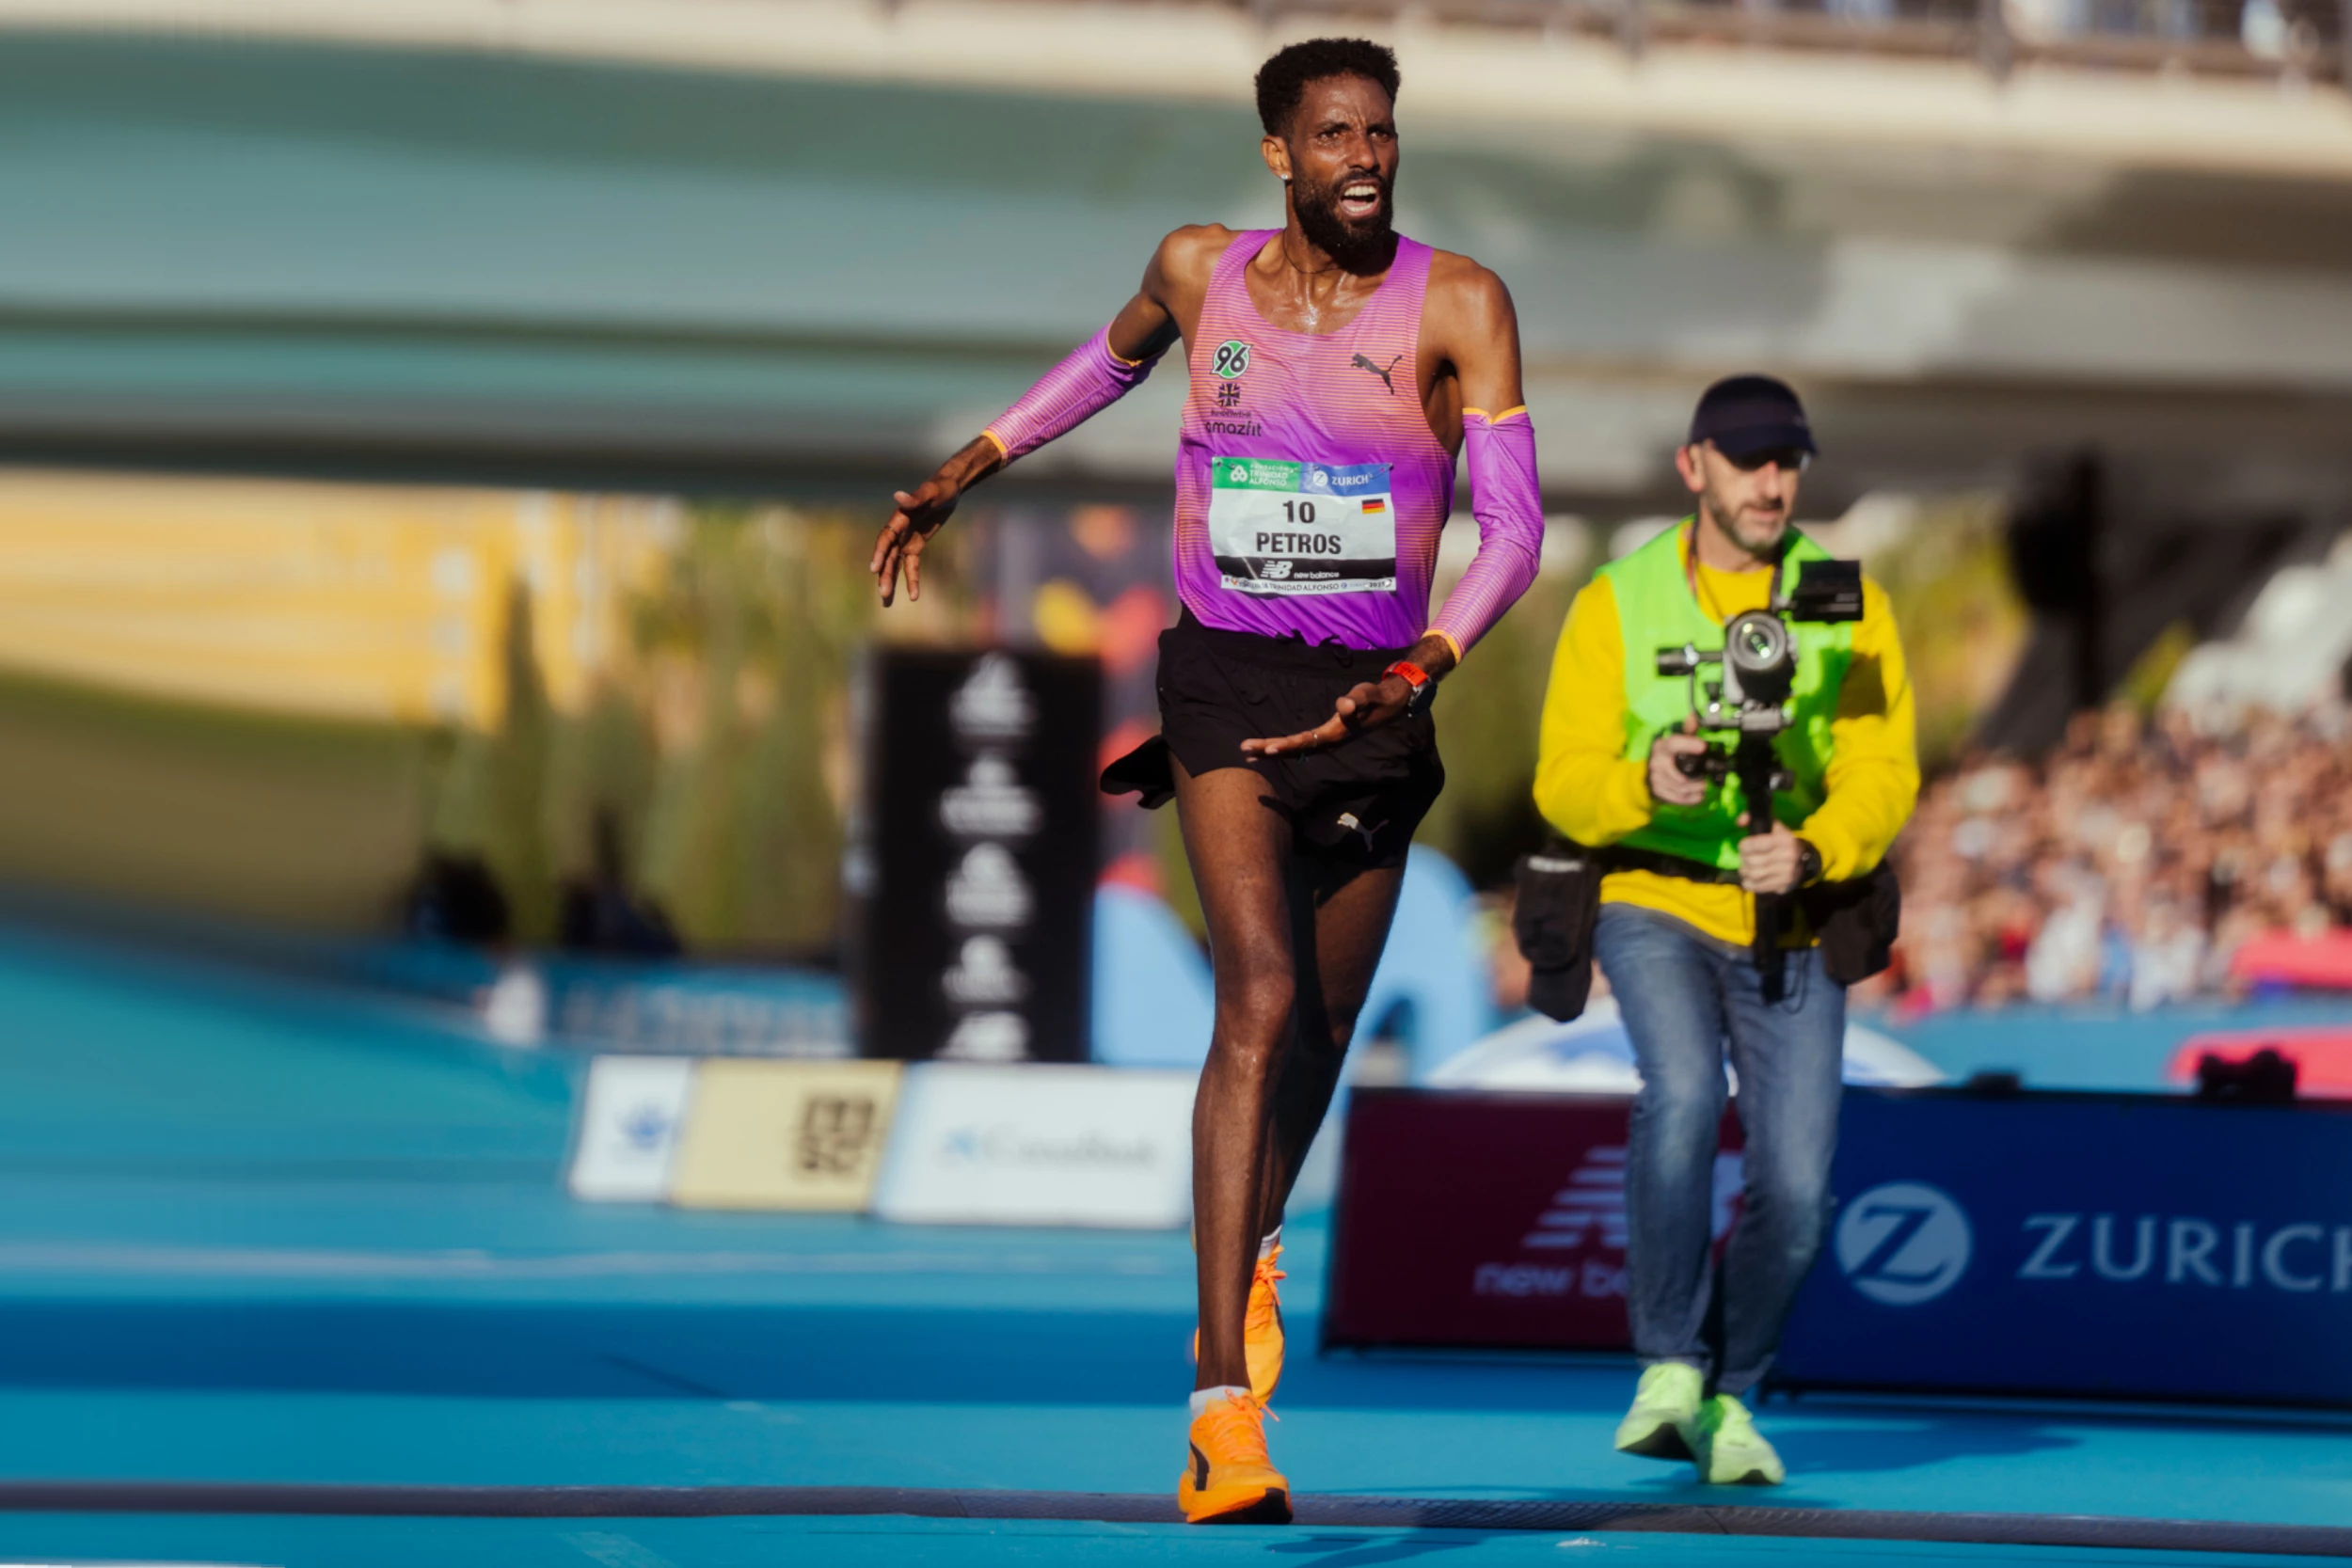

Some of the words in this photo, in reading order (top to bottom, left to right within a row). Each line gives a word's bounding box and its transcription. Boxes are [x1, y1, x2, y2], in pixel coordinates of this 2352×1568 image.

[1215, 344, 1248, 373] 96
[1331, 474, 1369, 486] ZURICH
[1282, 499, 1315, 524] 10
[1256, 531, 1342, 555] PETROS
[1310, 570, 1340, 579] balance
[1303, 583, 1340, 592] ALFONSO
[1473, 1263, 1572, 1296] new
